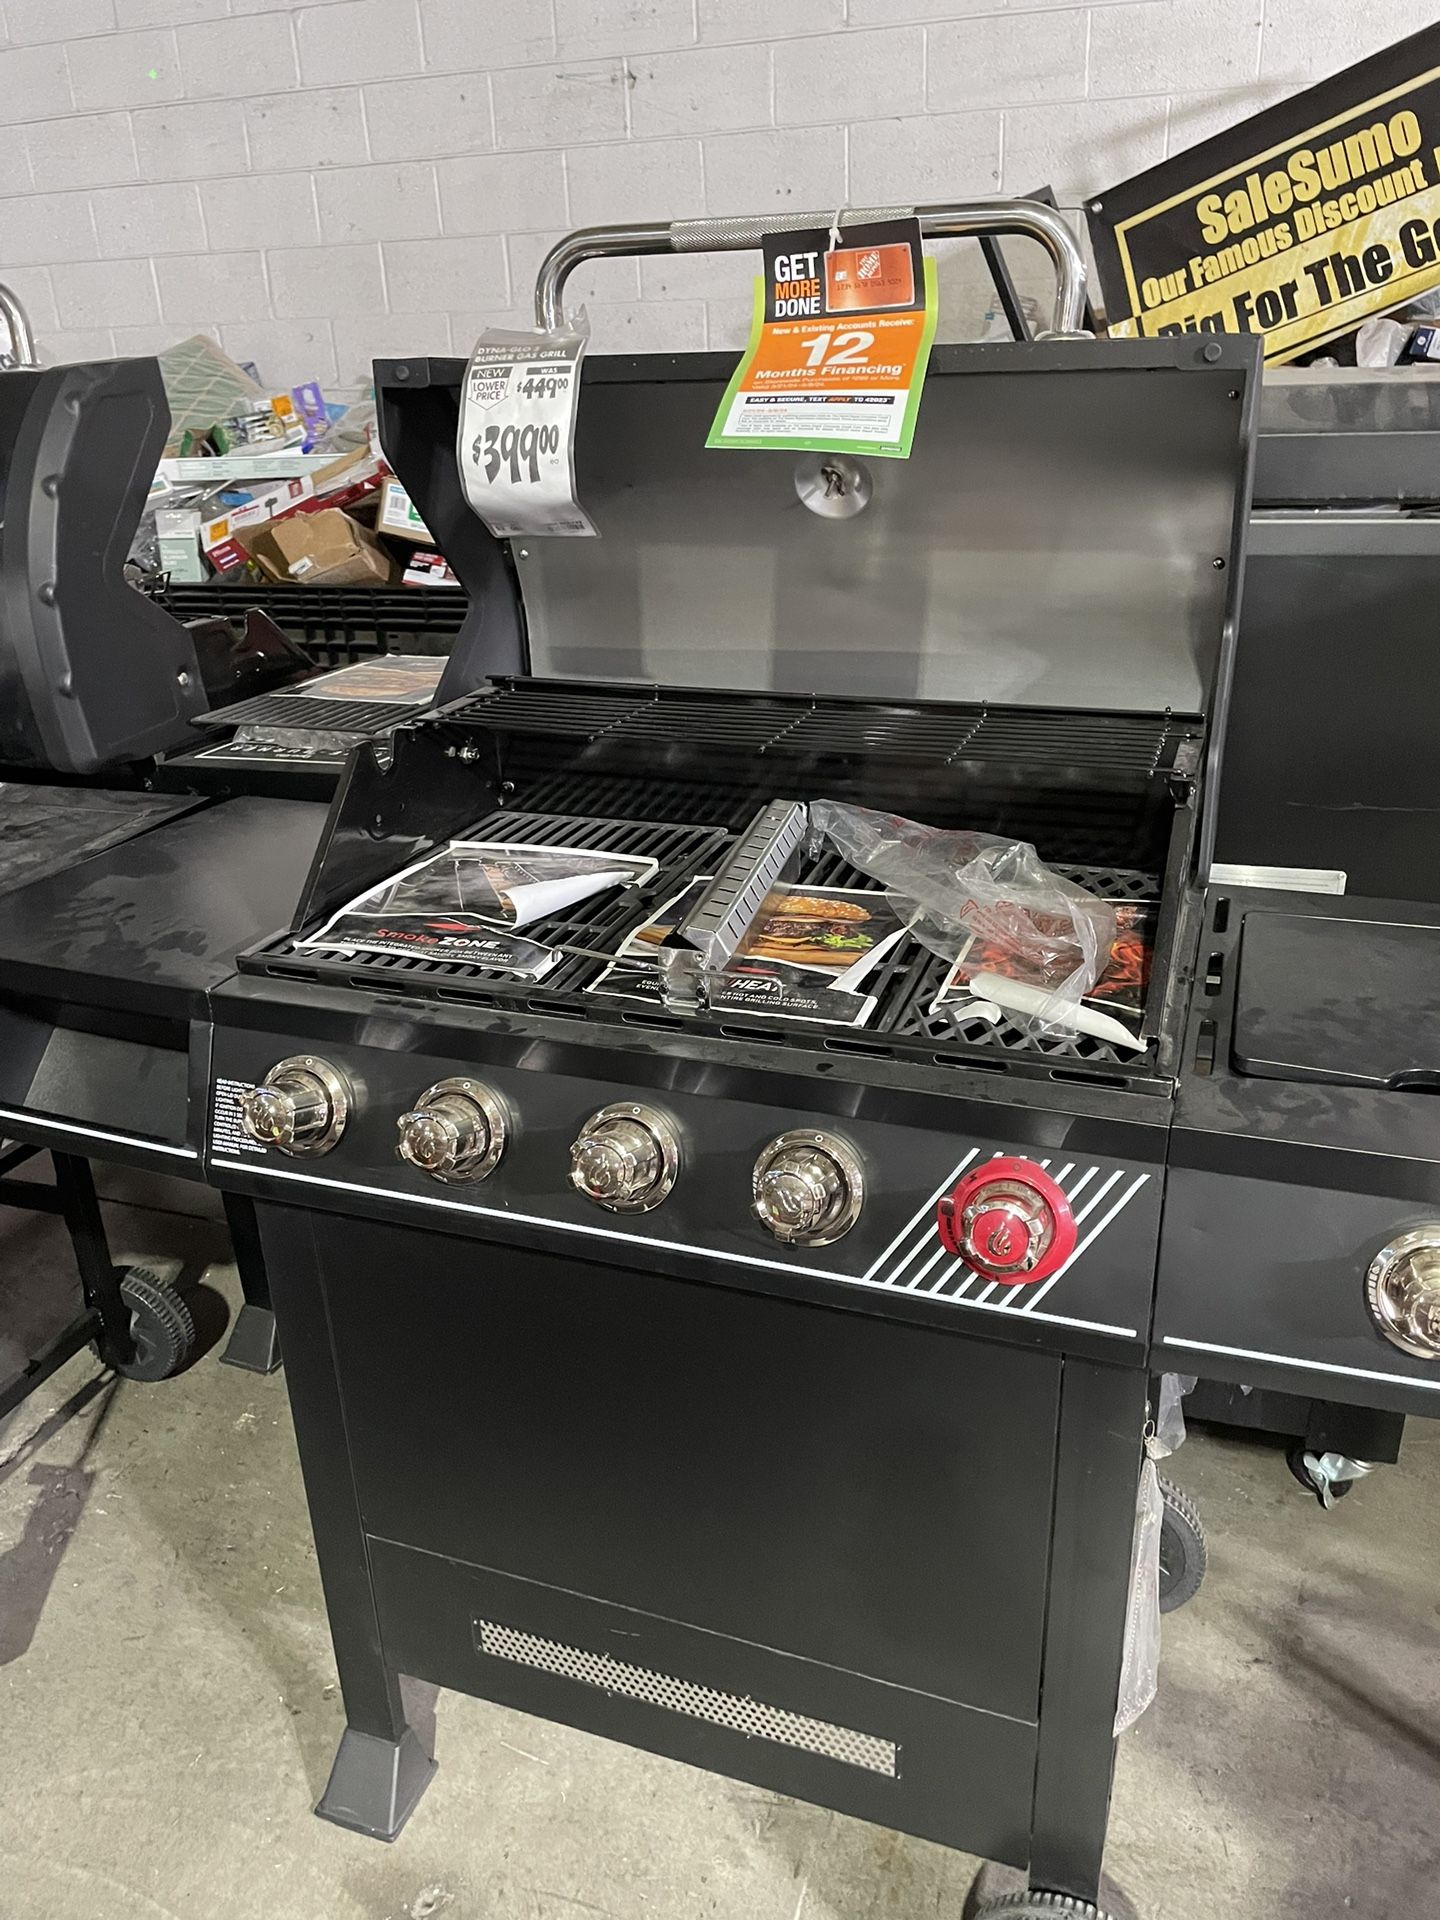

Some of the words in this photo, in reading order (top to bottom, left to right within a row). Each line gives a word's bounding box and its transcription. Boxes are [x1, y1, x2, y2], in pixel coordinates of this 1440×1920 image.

[1195, 110, 1422, 245] SaleSumo
[1141, 268, 1188, 309] Our
[1188, 222, 1293, 288] Famous
[1293, 158, 1429, 243] Discount
[774, 252, 818, 283] GET
[775, 278, 821, 300] MORE
[1232, 278, 1299, 334] For
[1303, 243, 1394, 307] The
[775, 296, 821, 318] DONE
[772, 327, 791, 335] New
[801, 324, 835, 334] Existing
[836, 321, 877, 331] Accounts
[474, 353, 514, 363] BURNER
[516, 352, 537, 360] GAS
[539, 350, 567, 359] GRILL
[801, 331, 875, 367] 12
[476, 368, 505, 379] NEW
[755, 367, 816, 379] Months
[473, 381, 506, 392] LOWER
[476, 391, 501, 401] PRICE
[744, 998, 781, 1006] GRILLING
